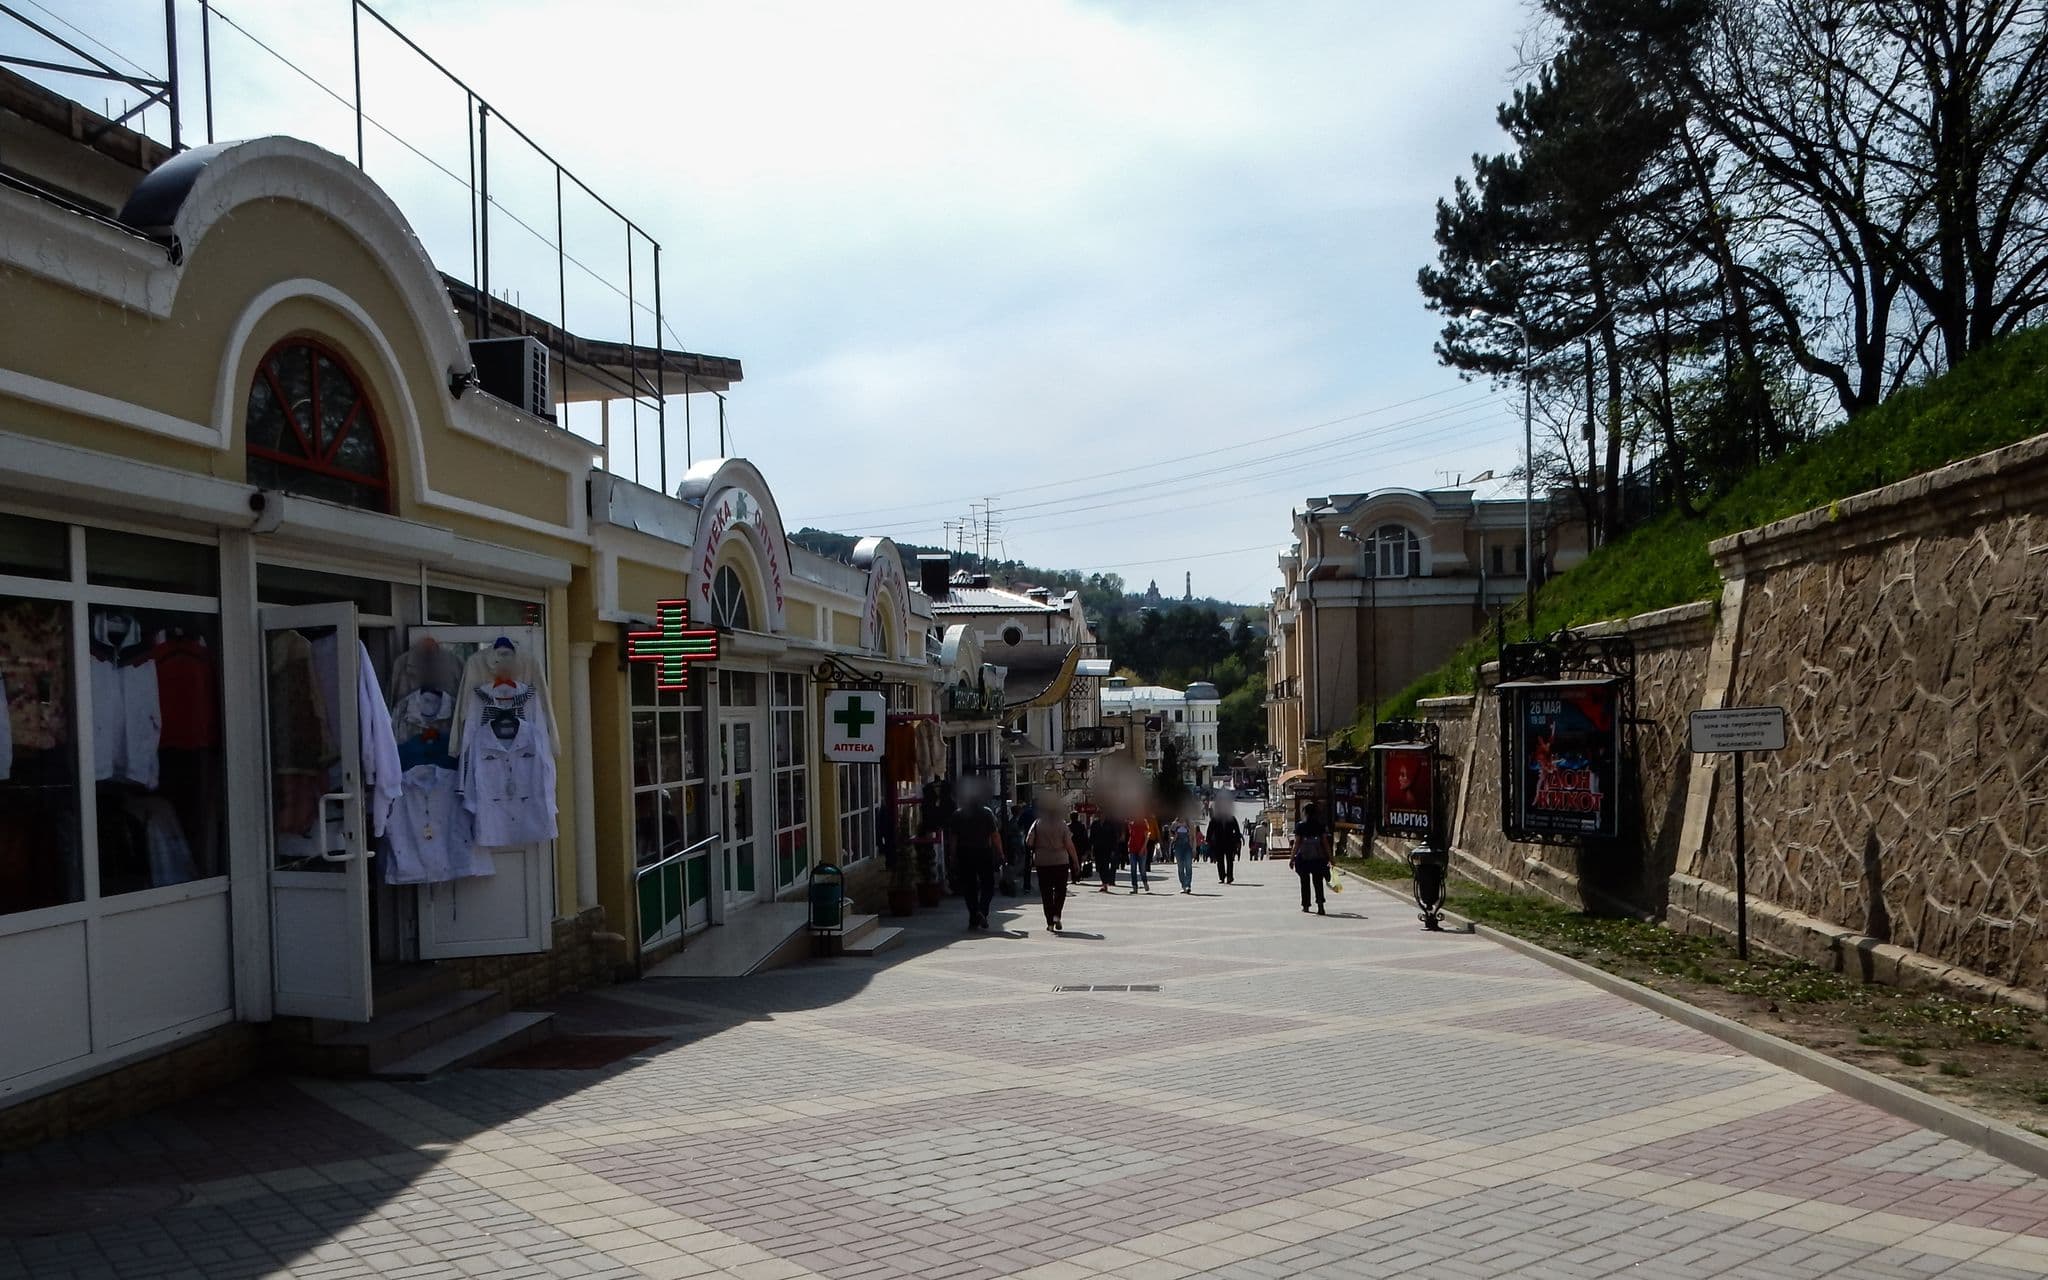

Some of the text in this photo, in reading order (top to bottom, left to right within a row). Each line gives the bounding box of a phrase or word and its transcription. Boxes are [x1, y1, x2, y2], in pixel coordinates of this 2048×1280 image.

[702, 500, 784, 613] АПТЕКА ОПТИКА
[1530, 701, 1561, 714] 26 МАЯ
[834, 743, 874, 752] АПТЕКА
[1536, 791, 1603, 812] КИХОТ
[1390, 812, 1428, 827] НАРГИЗ
